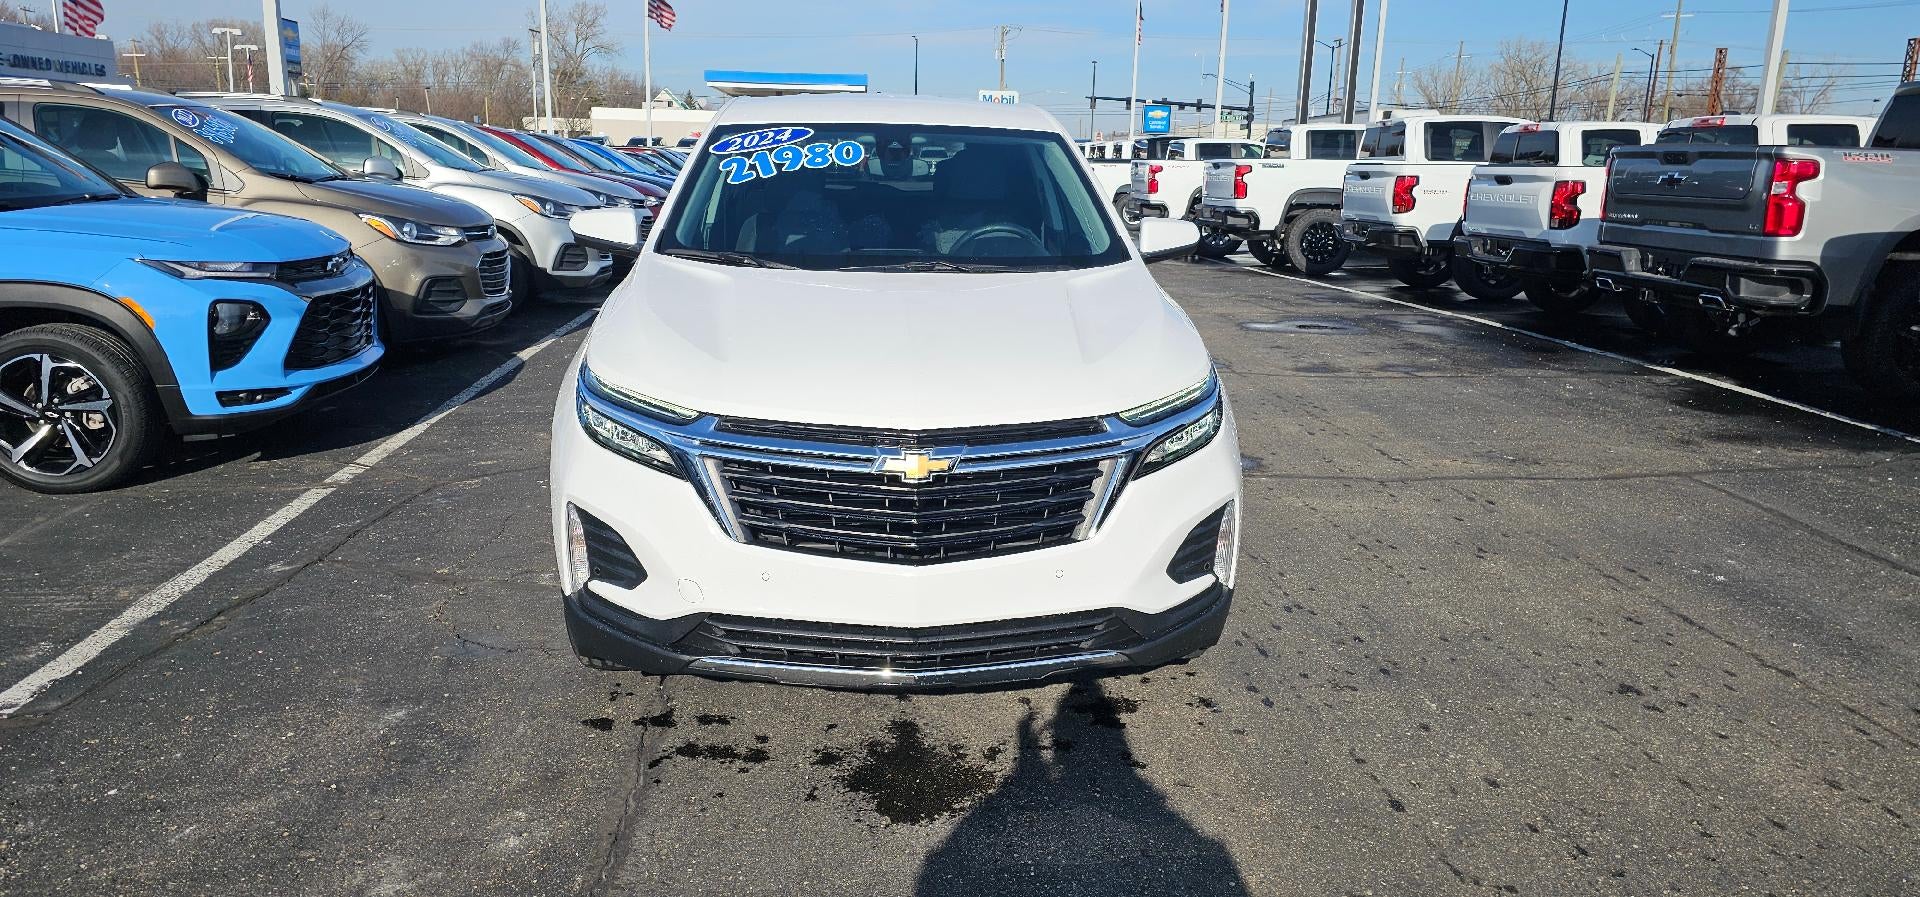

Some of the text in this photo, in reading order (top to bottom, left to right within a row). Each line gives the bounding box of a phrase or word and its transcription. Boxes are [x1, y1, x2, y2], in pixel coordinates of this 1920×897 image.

[55, 60, 107, 77] VEHICLES
[982, 94, 1015, 104] Mobil
[726, 128, 793, 151] 2024
[719, 141, 865, 184] 21980
[1470, 193, 1537, 205] CHEVROLET
